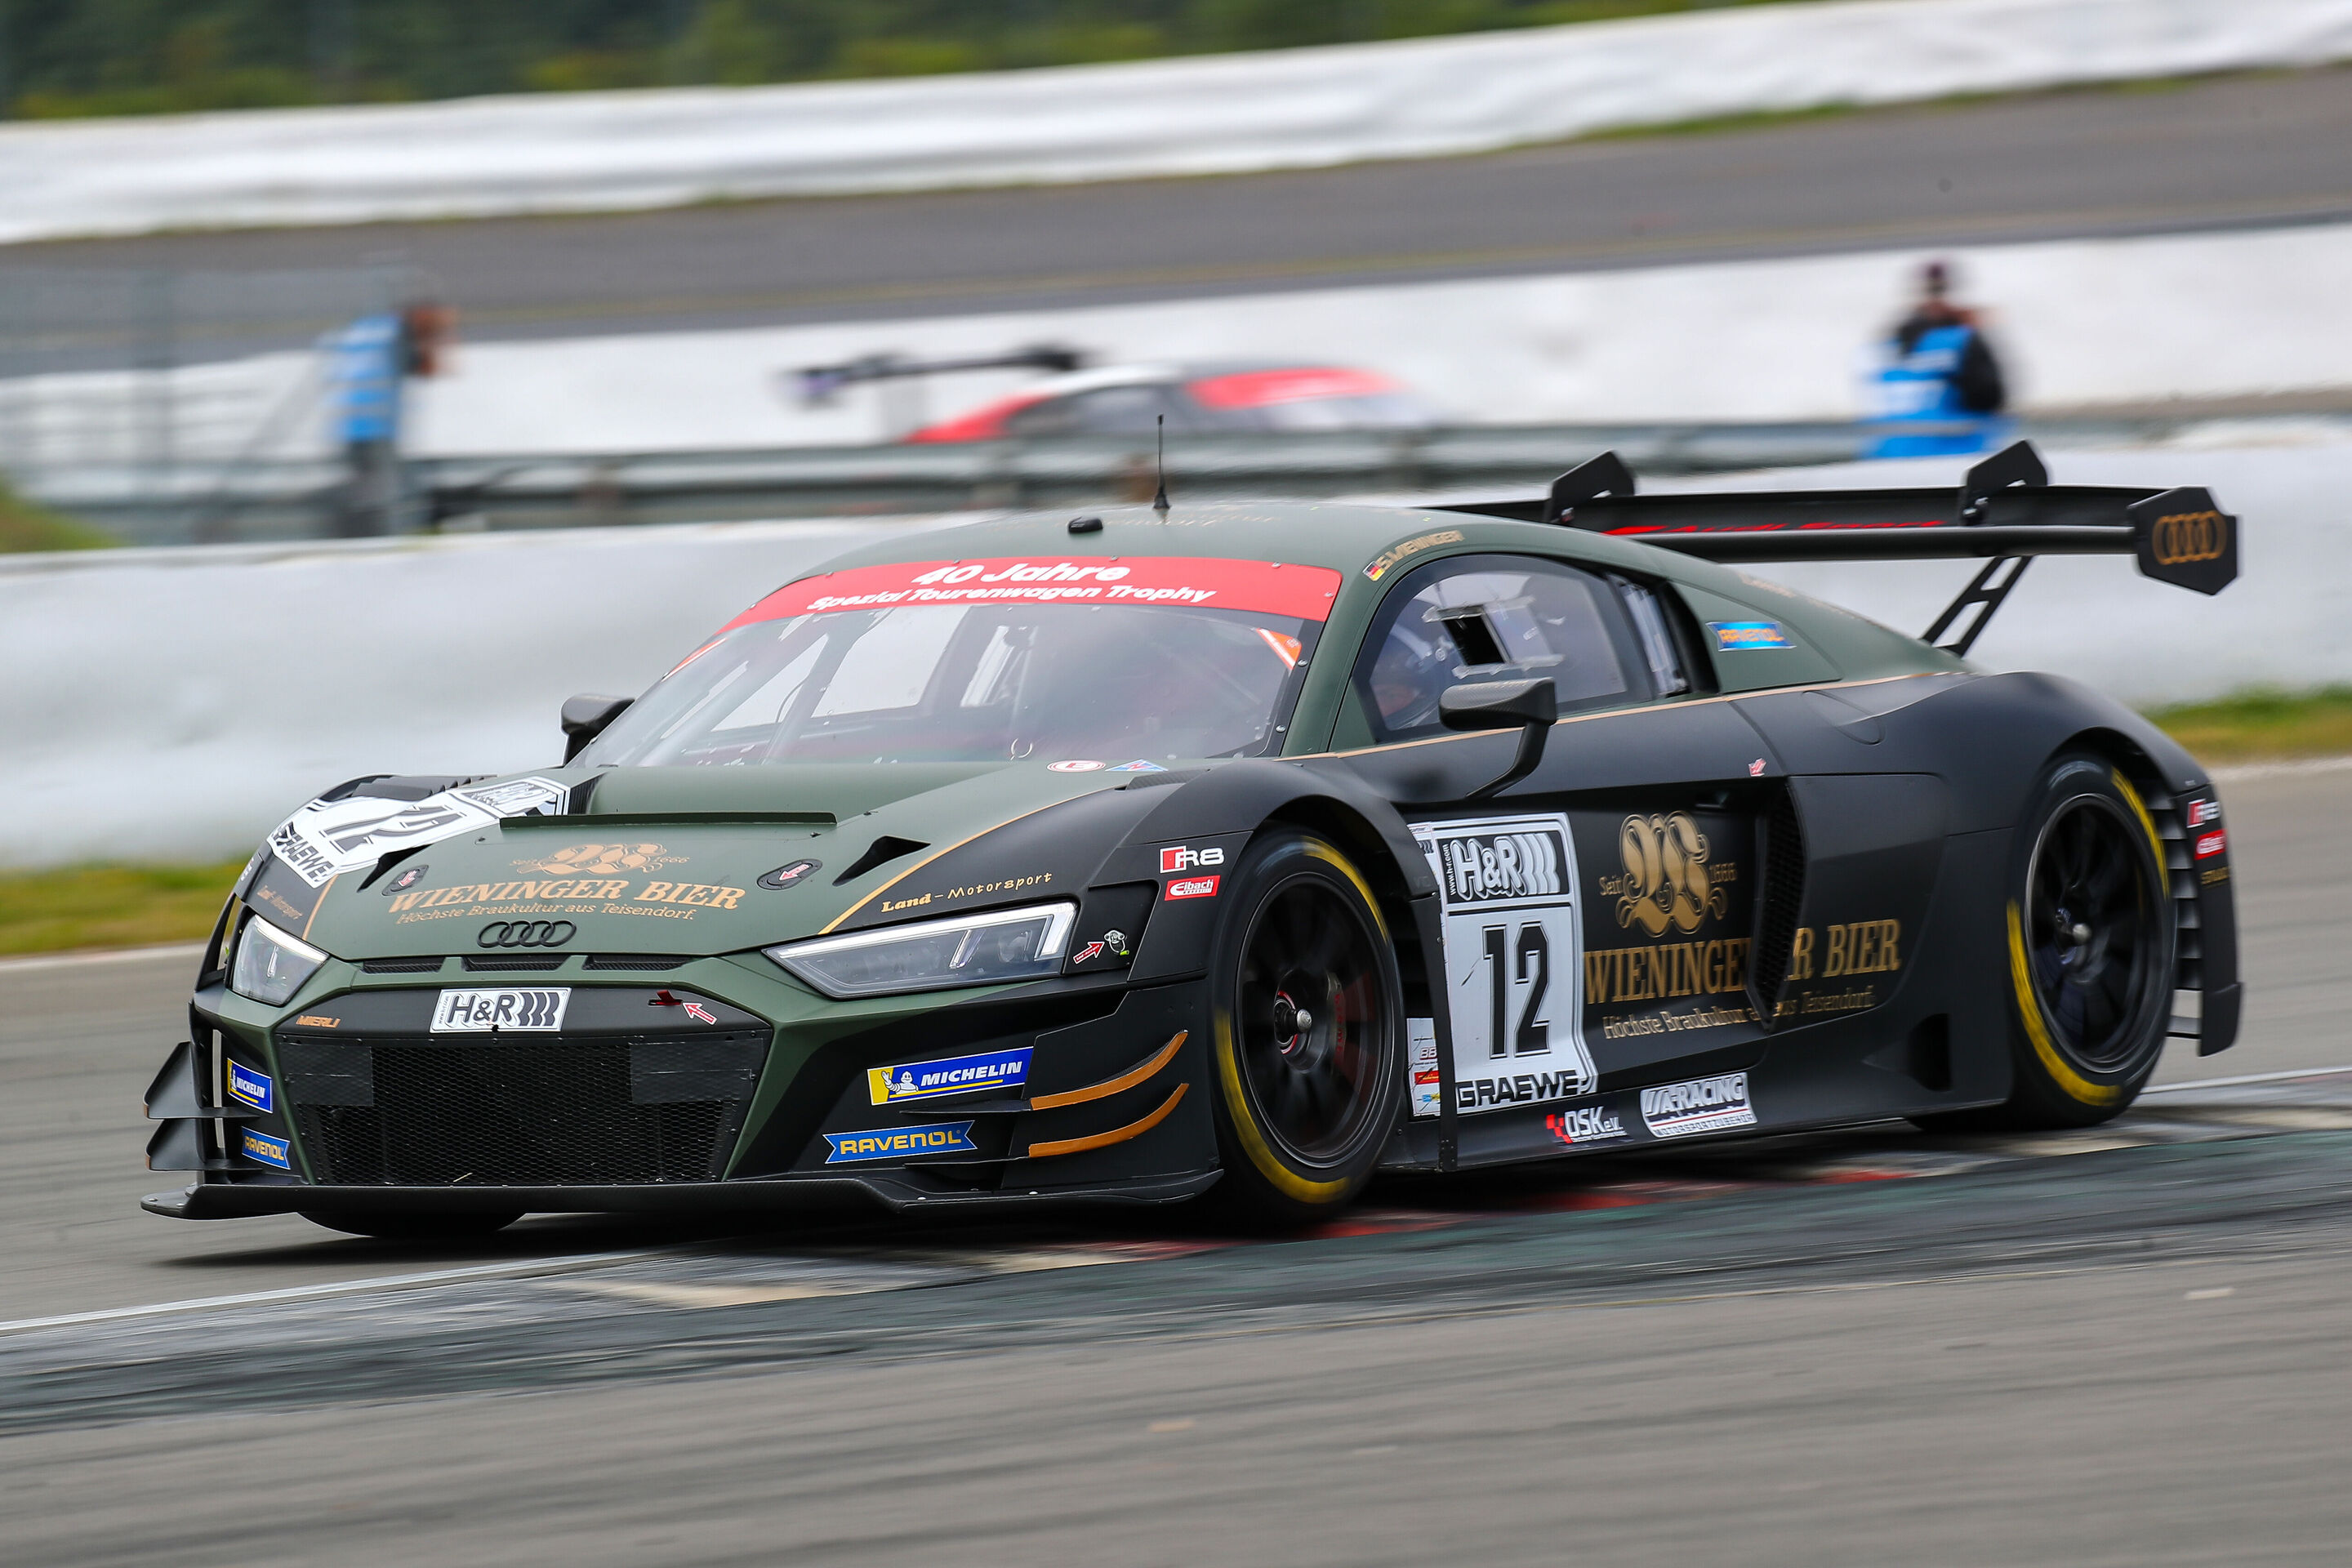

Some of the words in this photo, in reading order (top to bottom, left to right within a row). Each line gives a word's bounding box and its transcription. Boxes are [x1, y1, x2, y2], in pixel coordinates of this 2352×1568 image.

[911, 564, 984, 585] 40
[980, 563, 1131, 583] Jahre
[807, 589, 911, 611] Spezial
[906, 586, 1103, 601] Tourenwagen
[1105, 584, 1217, 603] Trophy
[1175, 848, 1225, 868] R8
[1443, 844, 1457, 896] www.h-r.com
[1450, 835, 1526, 900] H&R
[389, 880, 629, 913] WIENINGER
[635, 880, 746, 910] BIER
[1170, 879, 1214, 896] Eibach
[1599, 875, 1624, 896] Seit
[395, 907, 464, 924] Höchste
[469, 902, 564, 916] Braukultur
[565, 903, 595, 914] aus
[603, 902, 695, 920] Teisendorf.
[1822, 919, 1902, 978] BIER
[1481, 921, 1551, 1058] 12
[448, 994, 515, 1022] H&R
[1602, 1014, 1665, 1039] Höchste
[921, 1061, 1022, 1086] MICHELIN
[236, 1076, 265, 1098] MICHELIN
[1457, 1069, 1579, 1107] GRAEWE
[246, 1136, 284, 1160] RAVENOL
[840, 1130, 962, 1155] RAVENOL
